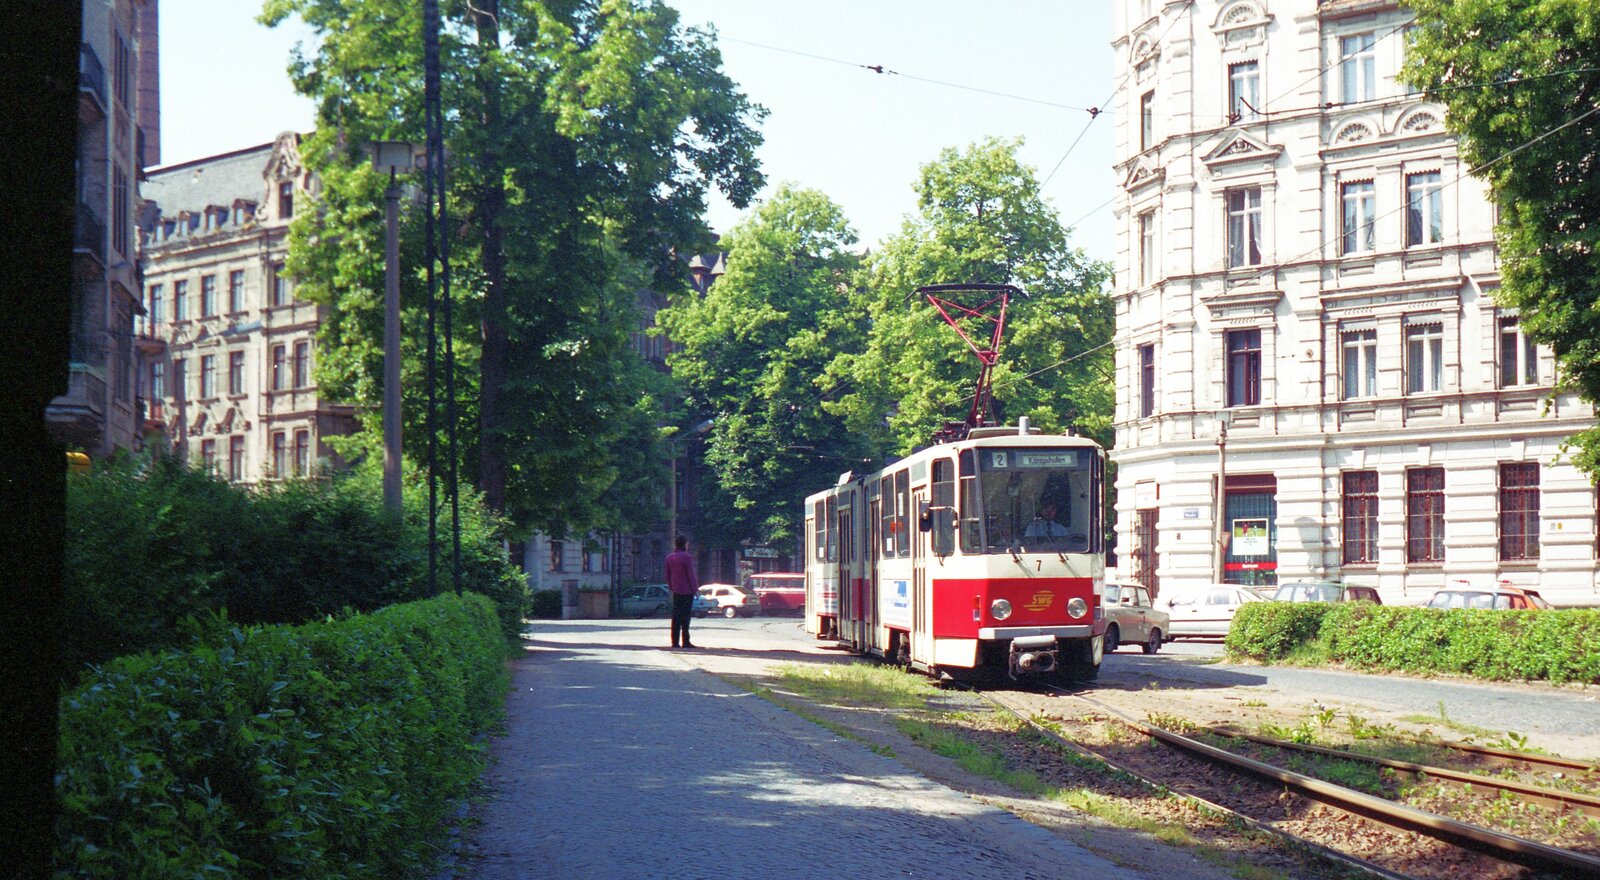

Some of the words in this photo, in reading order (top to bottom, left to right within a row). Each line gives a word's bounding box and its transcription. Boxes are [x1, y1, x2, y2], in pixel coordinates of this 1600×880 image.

[997, 454, 1003, 466] 2
[1036, 560, 1042, 571] 7
[1031, 594, 1054, 607] SWG
